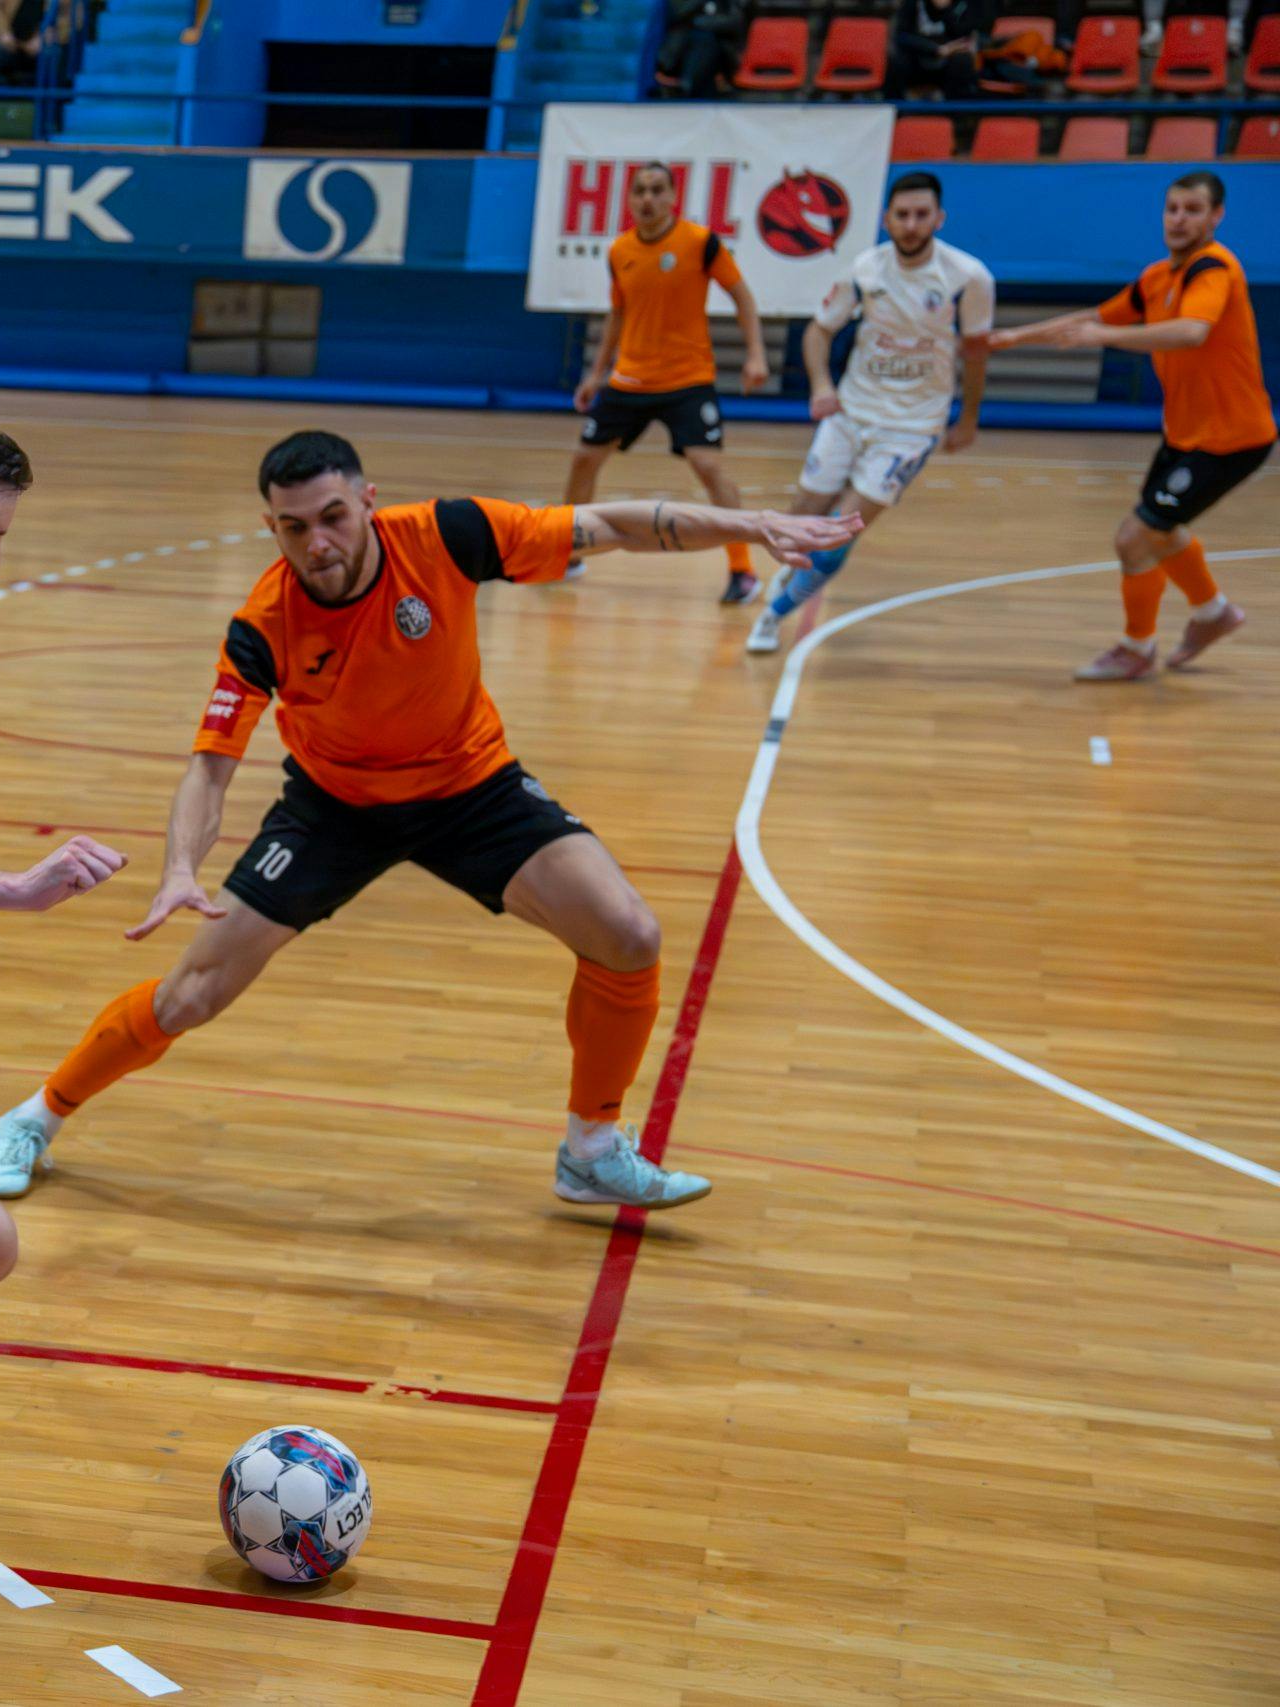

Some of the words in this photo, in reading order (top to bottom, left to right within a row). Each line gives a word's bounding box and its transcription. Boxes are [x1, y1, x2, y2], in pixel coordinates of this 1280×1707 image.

[562, 158, 739, 237] HL
[254, 841, 293, 881] 10
[336, 1486, 372, 1539] LECT
